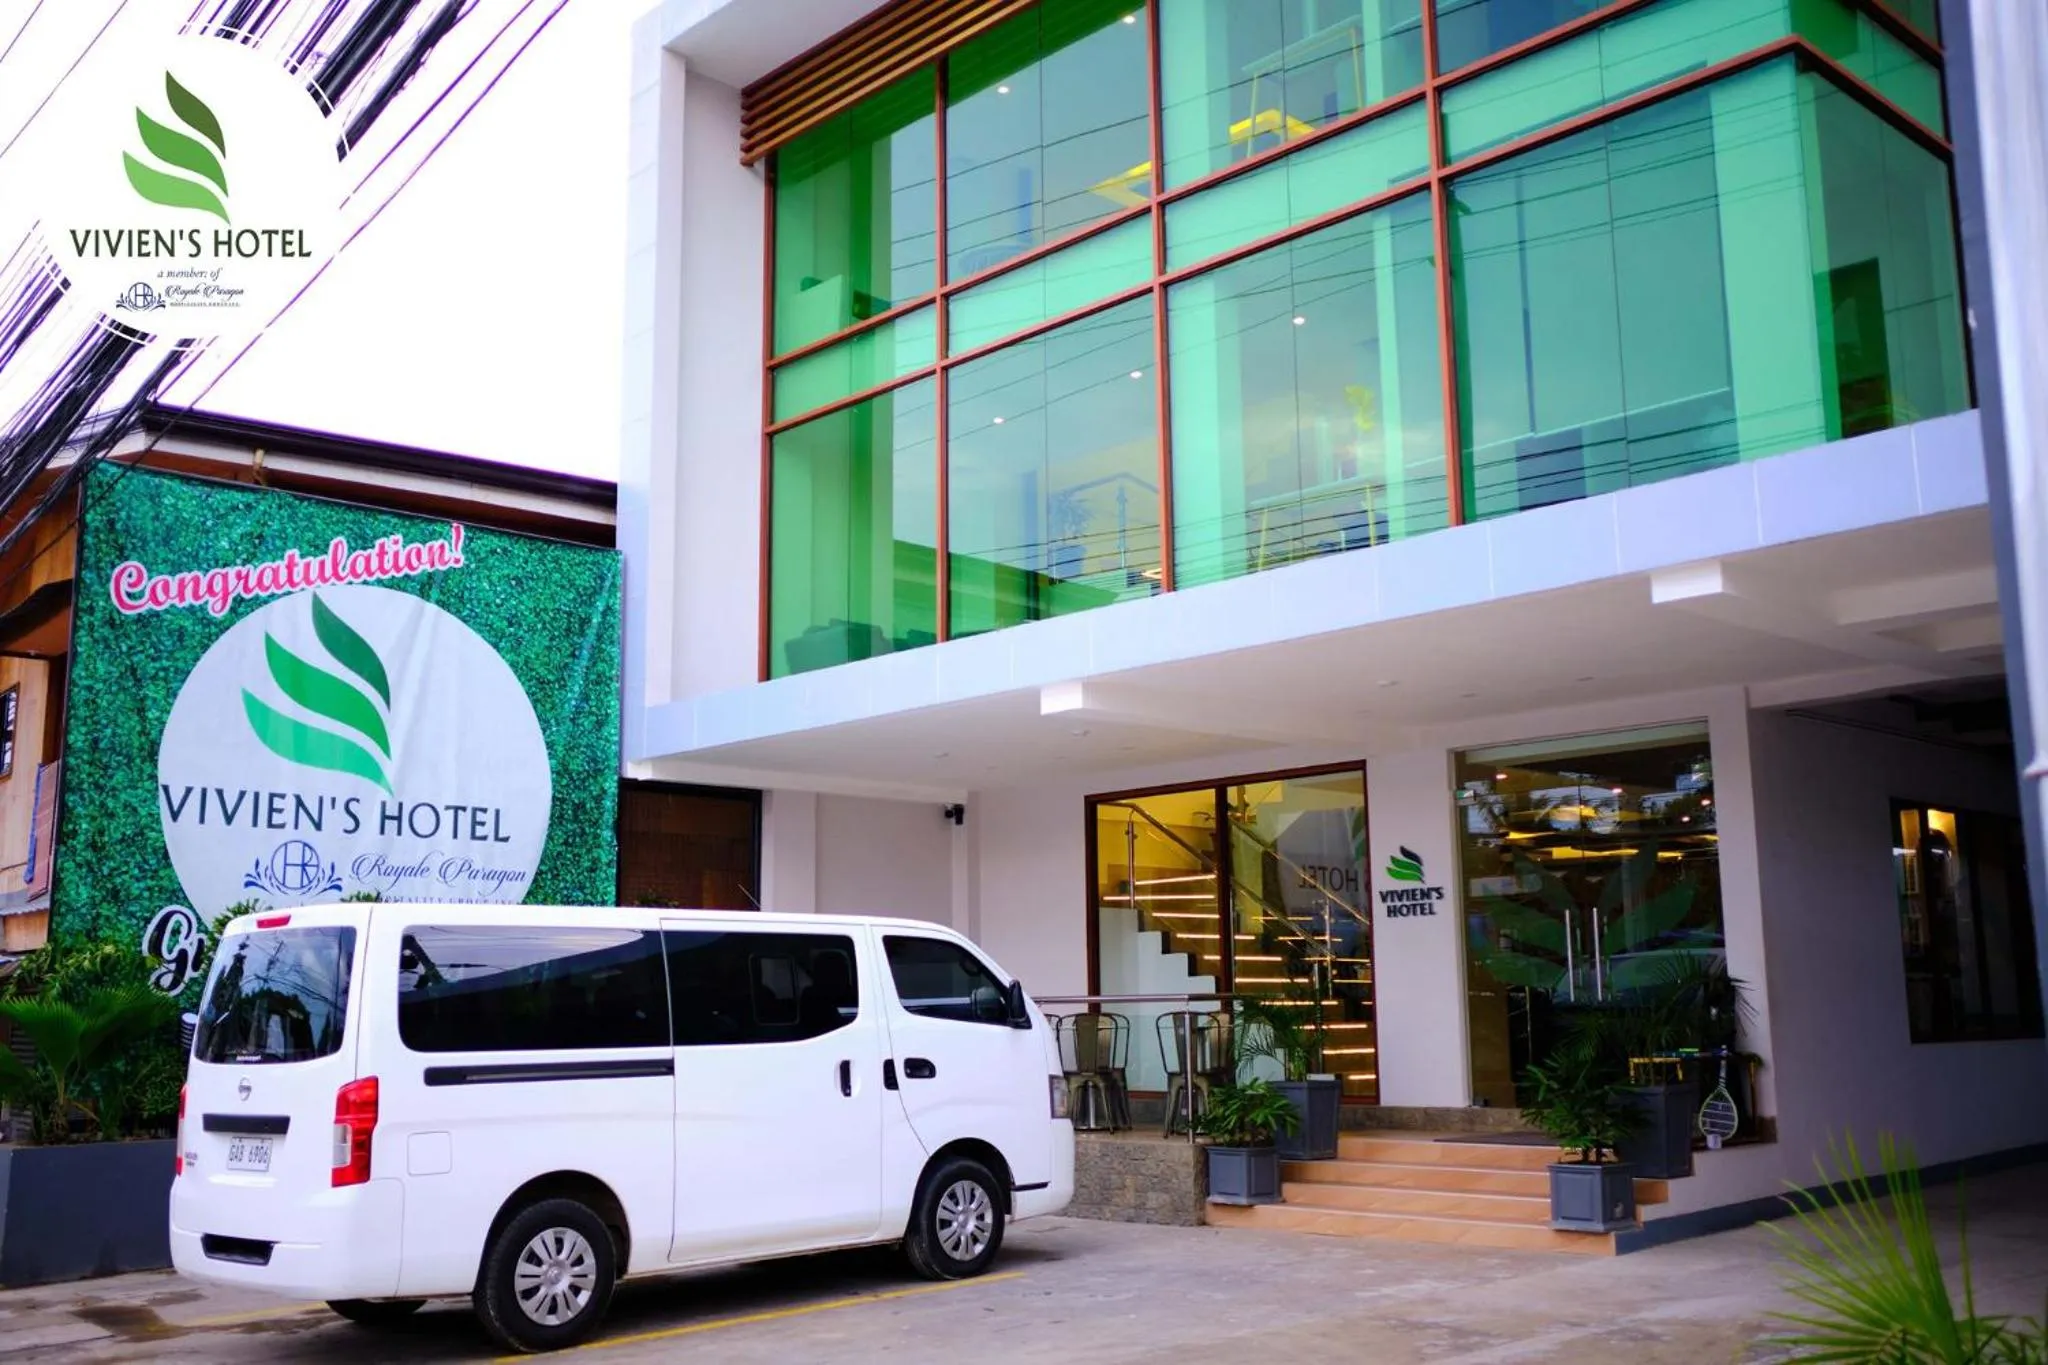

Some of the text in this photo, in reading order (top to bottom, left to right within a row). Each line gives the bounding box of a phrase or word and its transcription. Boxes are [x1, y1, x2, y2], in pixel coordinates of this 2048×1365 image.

[111, 522, 464, 616] Congratulation!
[160, 784, 511, 843] VIVIEN'S HOTEL
[351, 851, 527, 896] Royale Paragon
[1379, 886, 1445, 904] VIVIEN'S
[1386, 902, 1437, 918] HOTEL
